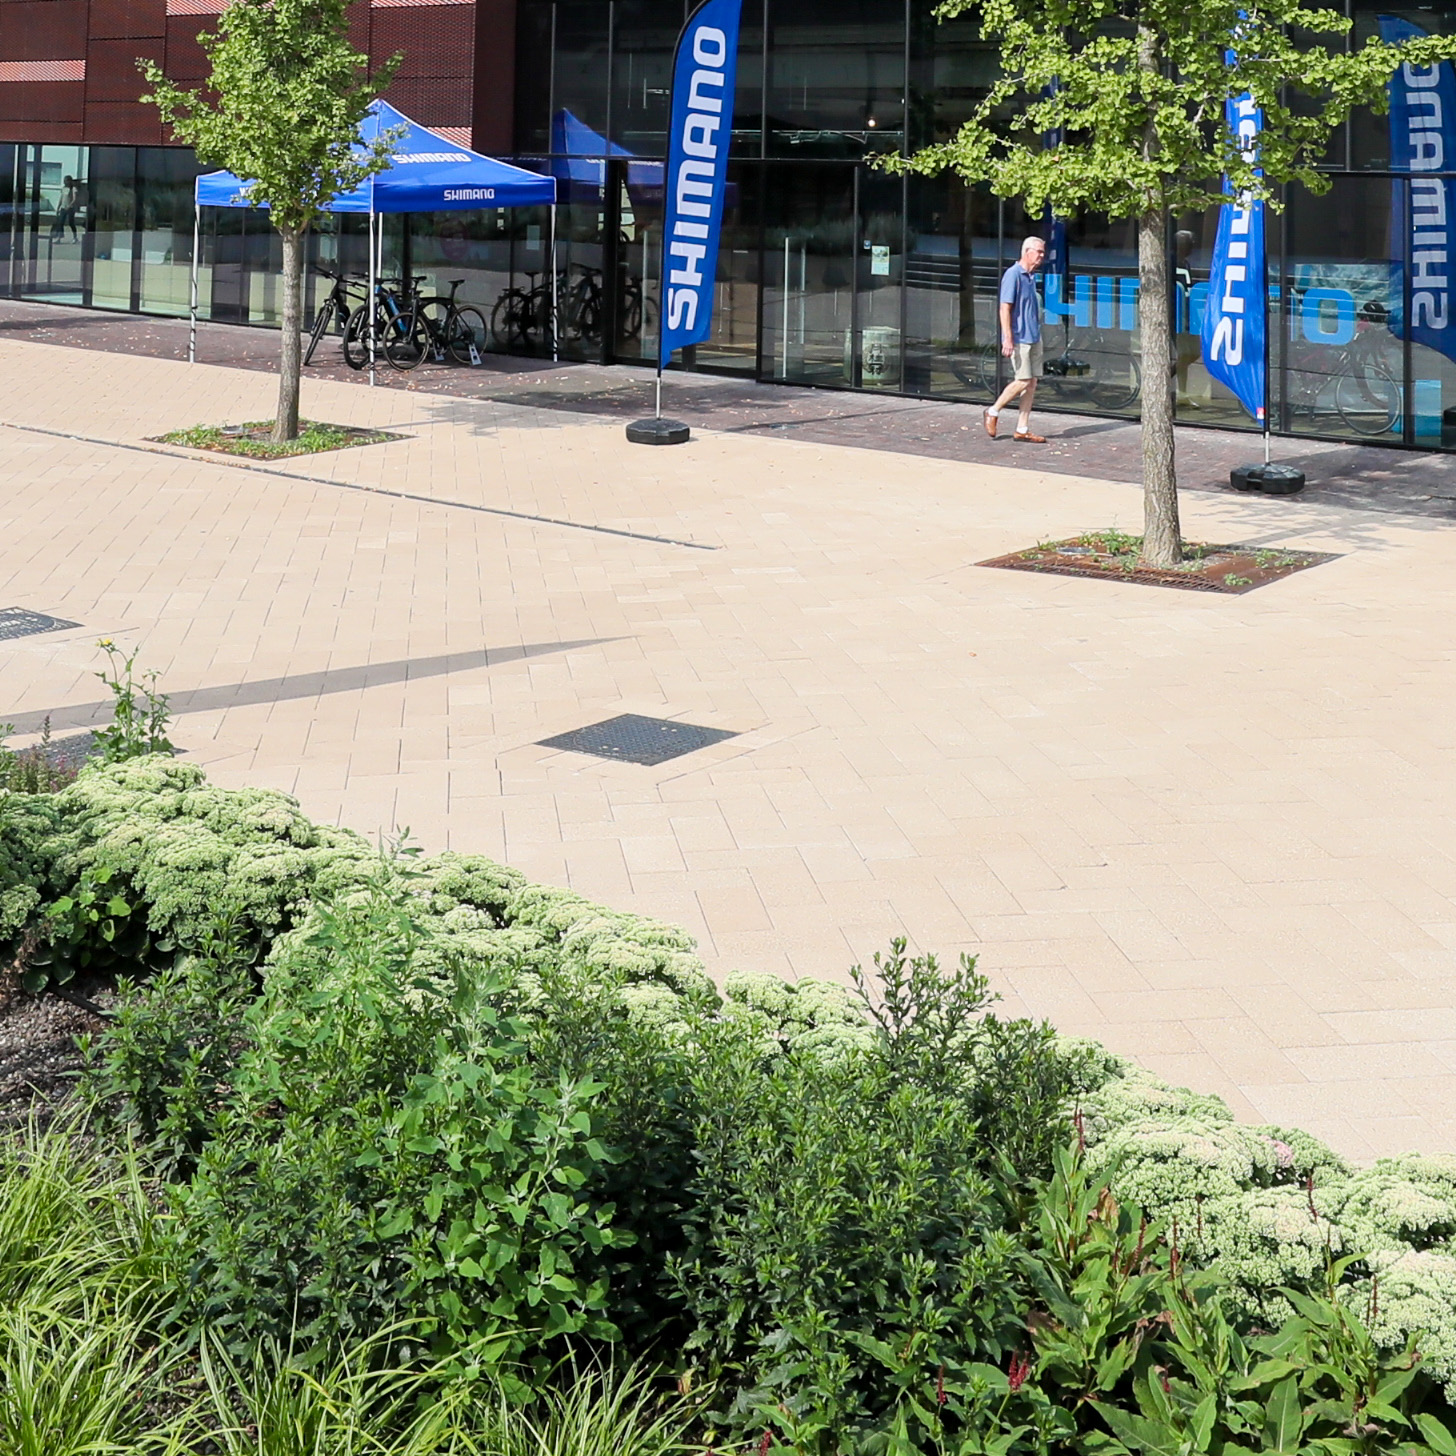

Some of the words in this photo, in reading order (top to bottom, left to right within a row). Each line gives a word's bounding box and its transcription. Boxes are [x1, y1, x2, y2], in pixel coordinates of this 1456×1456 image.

[391, 152, 473, 164] SHIMANO
[668, 26, 726, 332] SHIMANO
[444, 189, 495, 201] SHIMANO
